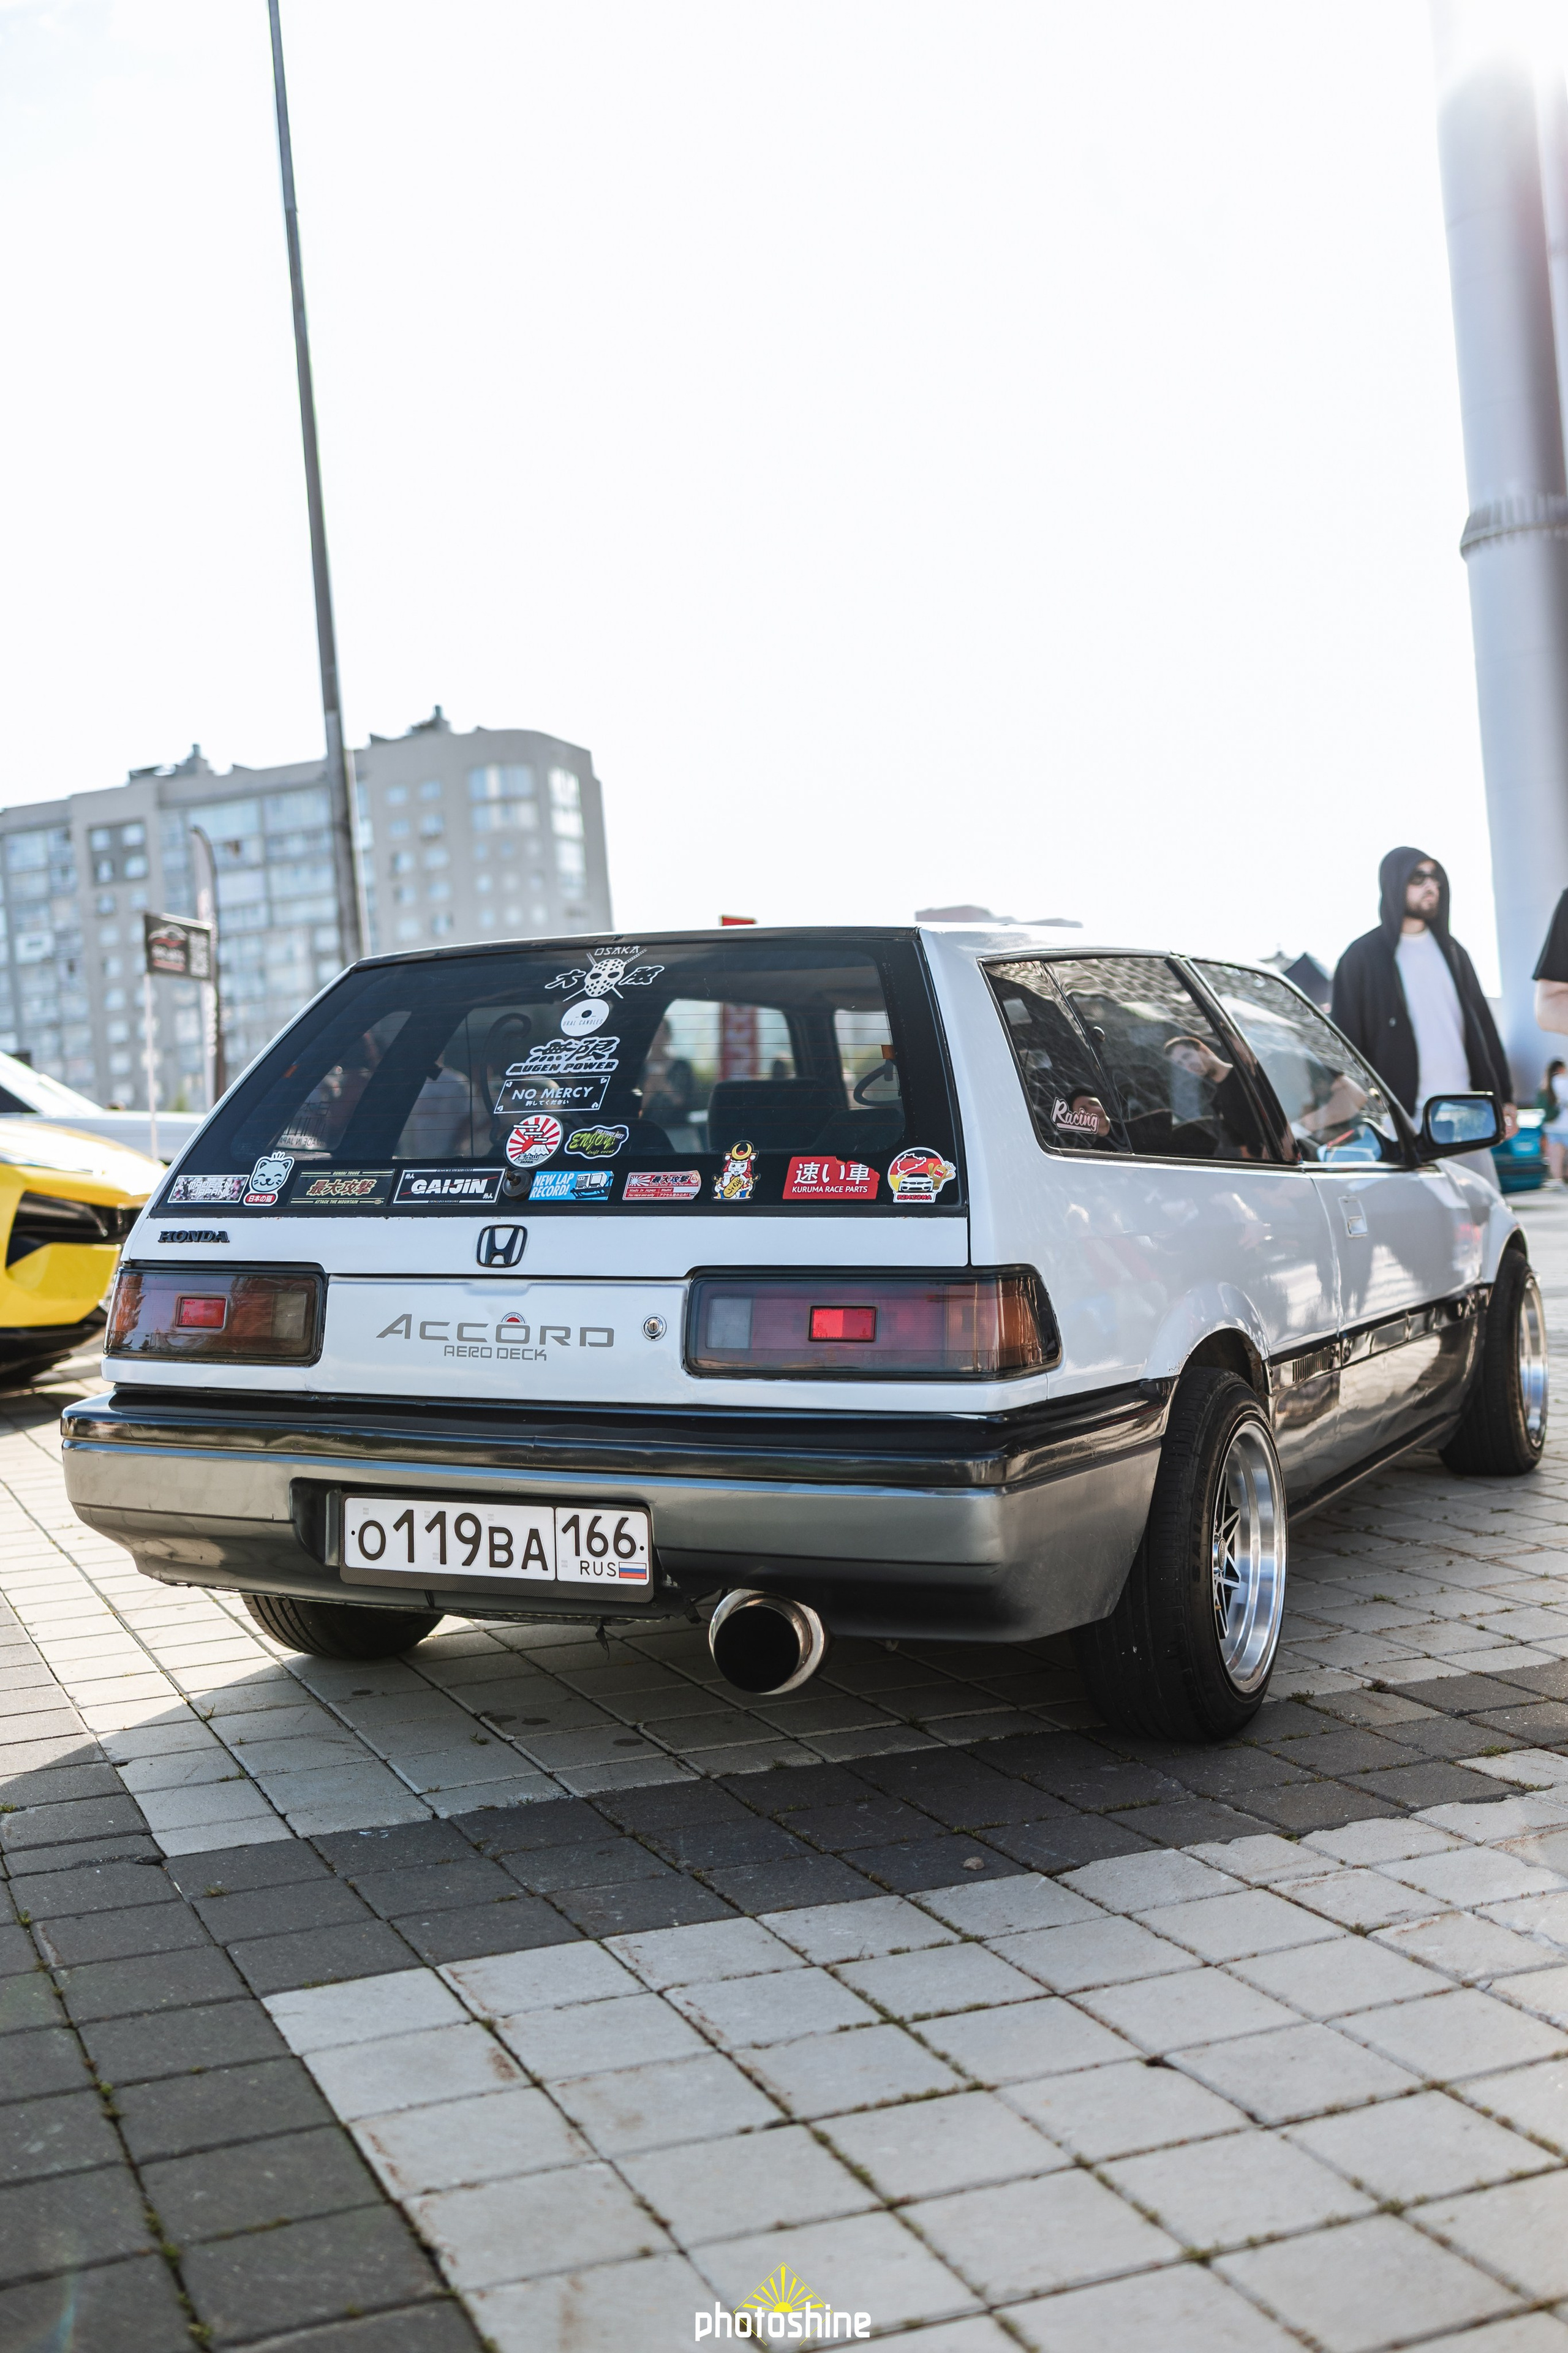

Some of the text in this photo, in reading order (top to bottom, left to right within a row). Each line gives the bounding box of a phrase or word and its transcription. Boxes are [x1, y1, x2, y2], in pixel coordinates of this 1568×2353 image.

[594, 946, 640, 956] OSAKA
[564, 1061, 615, 1071] POWER
[511, 1086, 594, 1100] NO MERCY
[1052, 1099, 1099, 1132] Racing
[532, 1173, 575, 1187] NEW LAP
[794, 1161, 870, 1185] 速い車
[306, 1179, 377, 1196] 最大攻撃
[410, 1179, 489, 1195] GAIJIN
[529, 1184, 571, 1198] RECORD!
[157, 1230, 230, 1243] HONDA
[375, 1313, 614, 1348] ACCORD
[444, 1345, 547, 1361] AERO DECK
[561, 1514, 637, 1560] 166
[579, 1560, 617, 1577] RUS
